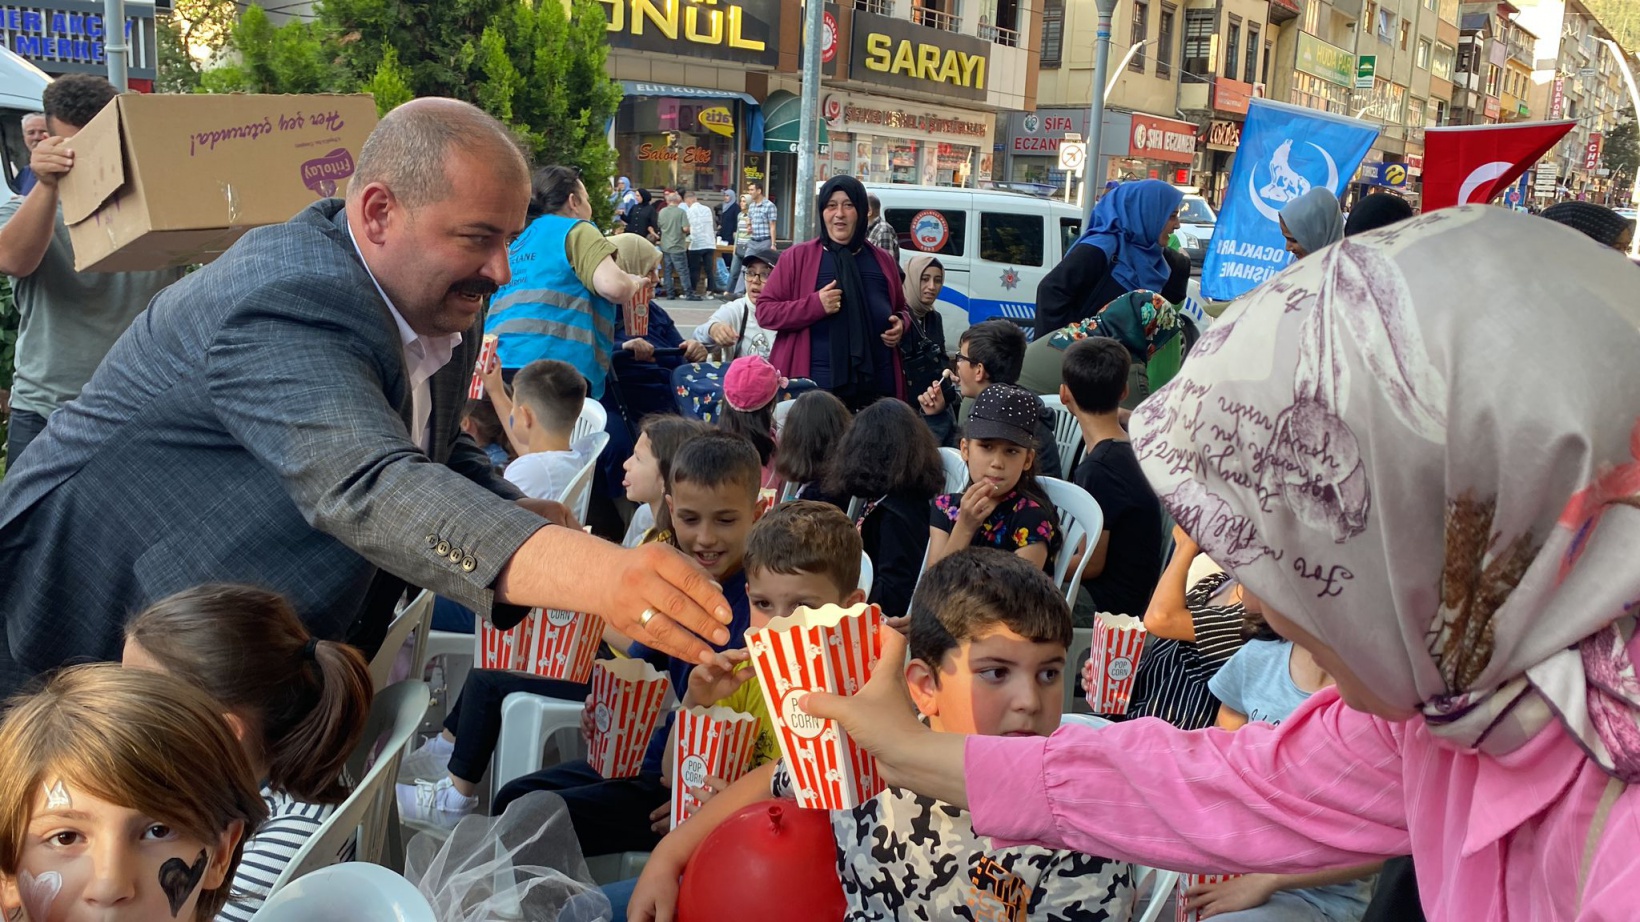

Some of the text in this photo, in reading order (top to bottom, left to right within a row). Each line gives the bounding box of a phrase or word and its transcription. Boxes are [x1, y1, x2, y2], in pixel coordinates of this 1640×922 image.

[51, 13, 133, 39] AKÇY
[604, 0, 765, 51] NÜL
[15, 35, 108, 62] MERKE
[865, 32, 986, 89] SARAYI
[309, 110, 345, 132] Her
[1044, 114, 1072, 133] ŞİFA
[637, 143, 678, 161] Salon
[1014, 137, 1066, 151] ECZAN
[1586, 144, 1598, 168] CHP
[1114, 661, 1128, 669] POP
[791, 713, 820, 729] CORN
[688, 760, 702, 772] POP
[685, 770, 703, 785] CORN
